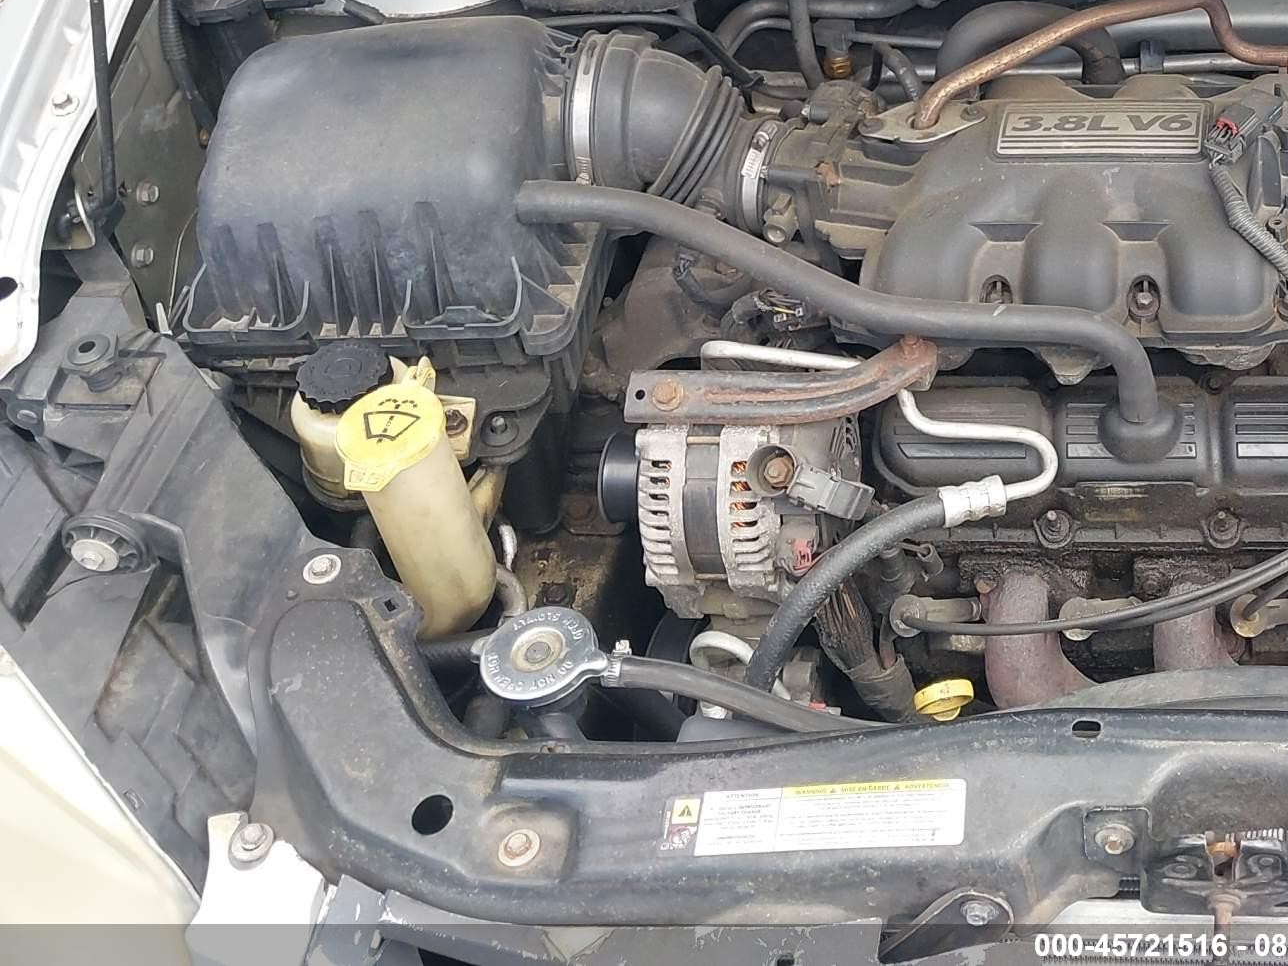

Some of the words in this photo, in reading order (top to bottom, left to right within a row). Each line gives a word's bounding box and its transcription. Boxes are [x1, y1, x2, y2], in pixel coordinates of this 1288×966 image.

[1011, 115, 1119, 132] 3.8L
[1128, 113, 1193, 132] V6
[557, 661, 574, 674] DO
[529, 673, 556, 692] NOT
